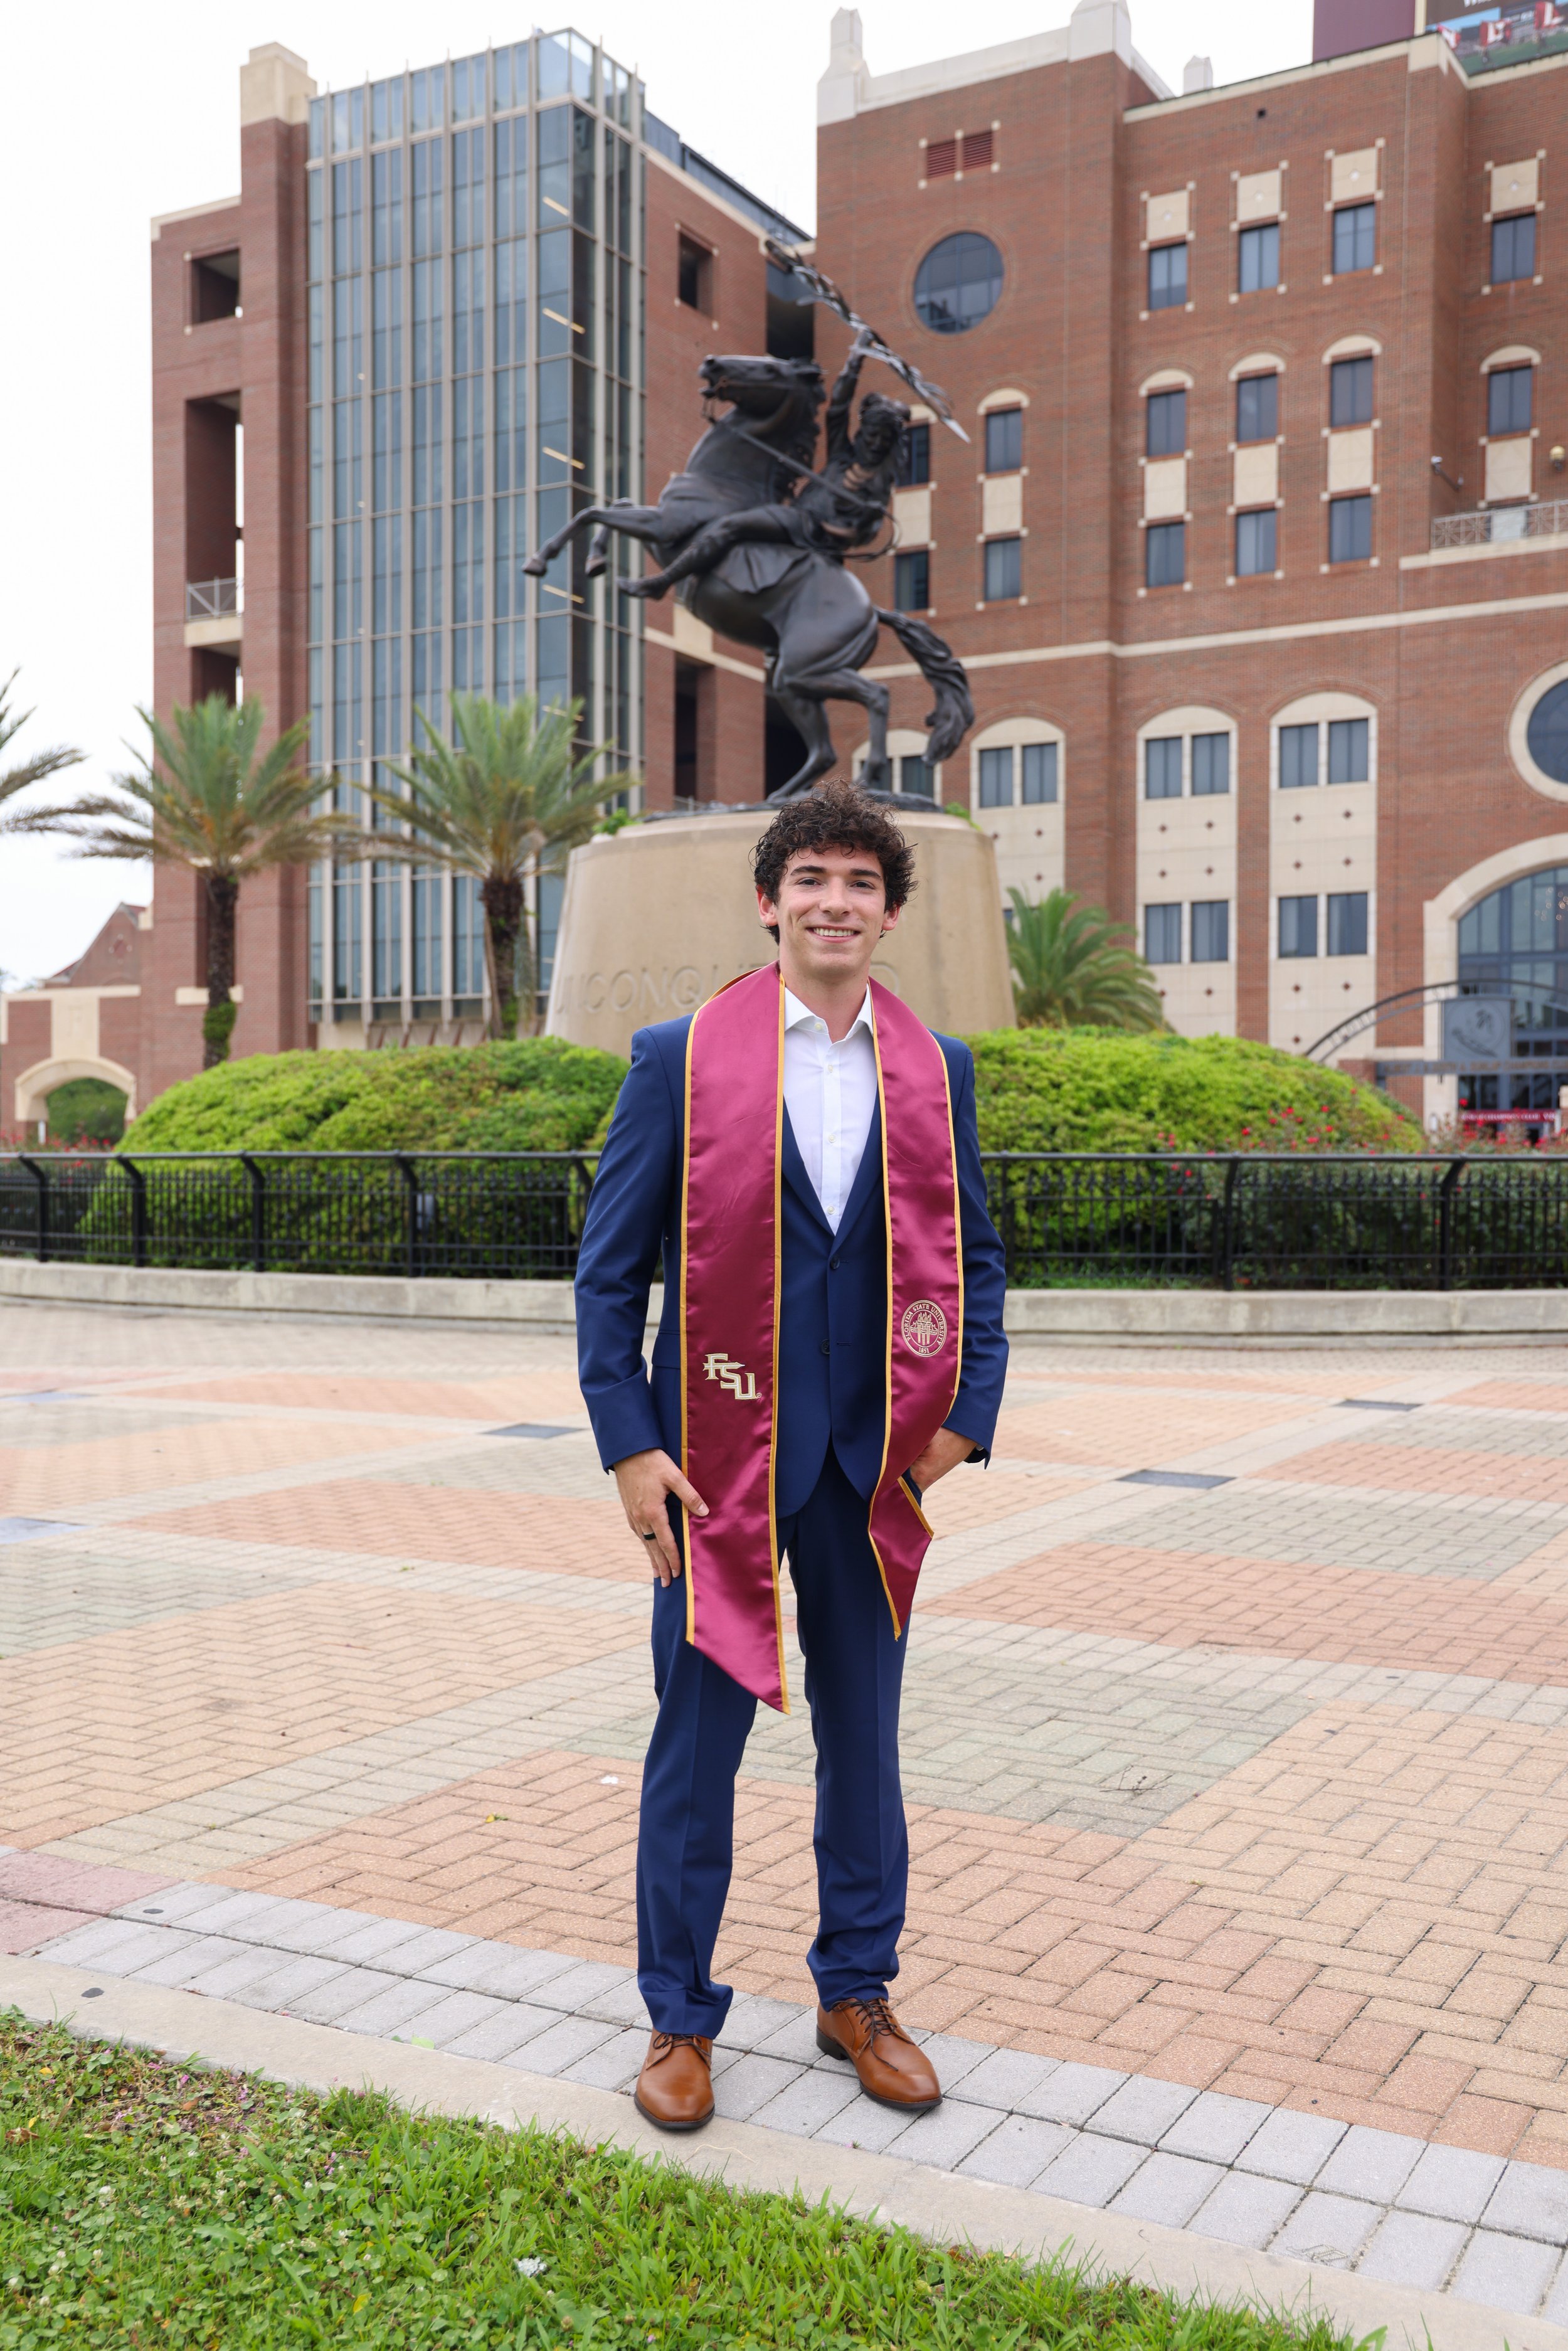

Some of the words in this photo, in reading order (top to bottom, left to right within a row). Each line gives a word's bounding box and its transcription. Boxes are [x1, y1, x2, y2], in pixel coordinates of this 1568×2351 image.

[904, 1311, 913, 1341] FLORIDA
[913, 1303, 930, 1312] STATE
[931, 1306, 944, 1345] UNIVERSITY
